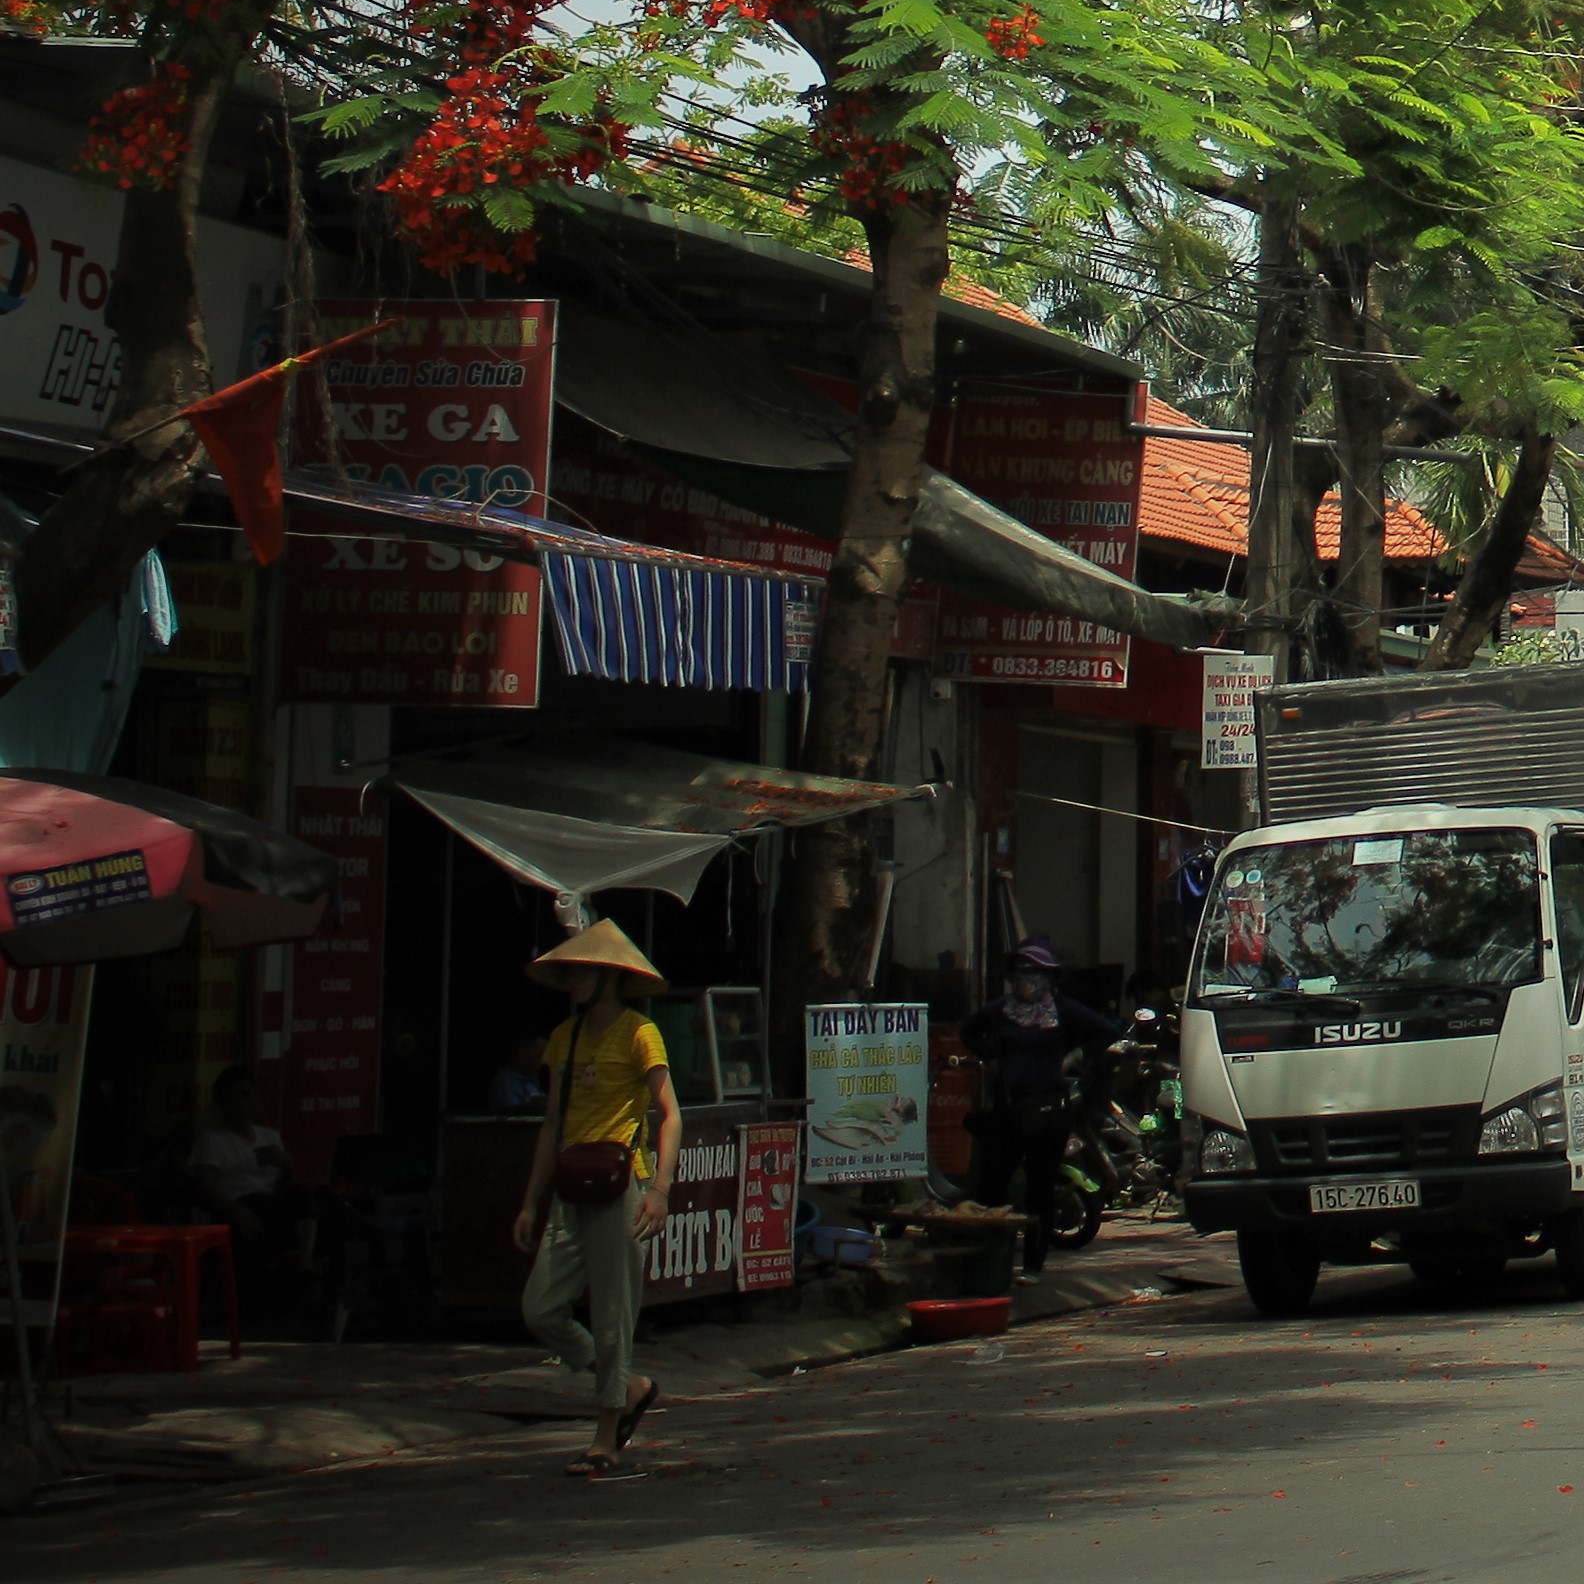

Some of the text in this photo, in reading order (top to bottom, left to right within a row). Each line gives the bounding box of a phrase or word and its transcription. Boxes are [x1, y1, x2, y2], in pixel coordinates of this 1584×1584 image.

[416, 359, 457, 387] Sửa
[466, 360, 524, 387] Chữa
[323, 403, 519, 442] XE GA
[1006, 456, 1077, 484] KHUNG
[323, 532, 408, 571] XE
[1090, 537, 1128, 565] MÁY
[418, 591, 461, 615] KIM
[467, 591, 528, 616] PHUN
[487, 669, 519, 695] Xe
[812, 1006, 919, 1042] TẠI ĐÂY BÁN
[1314, 1017, 1495, 1044] ISUZU QKR
[841, 1044, 859, 1068] CÁ
[858, 1072, 897, 1094] NHIÊN
[678, 1137, 715, 1183] BUÔN
[1315, 1184, 1416, 1210] 15C-276.40
[650, 1200, 736, 1289] THỊT B
